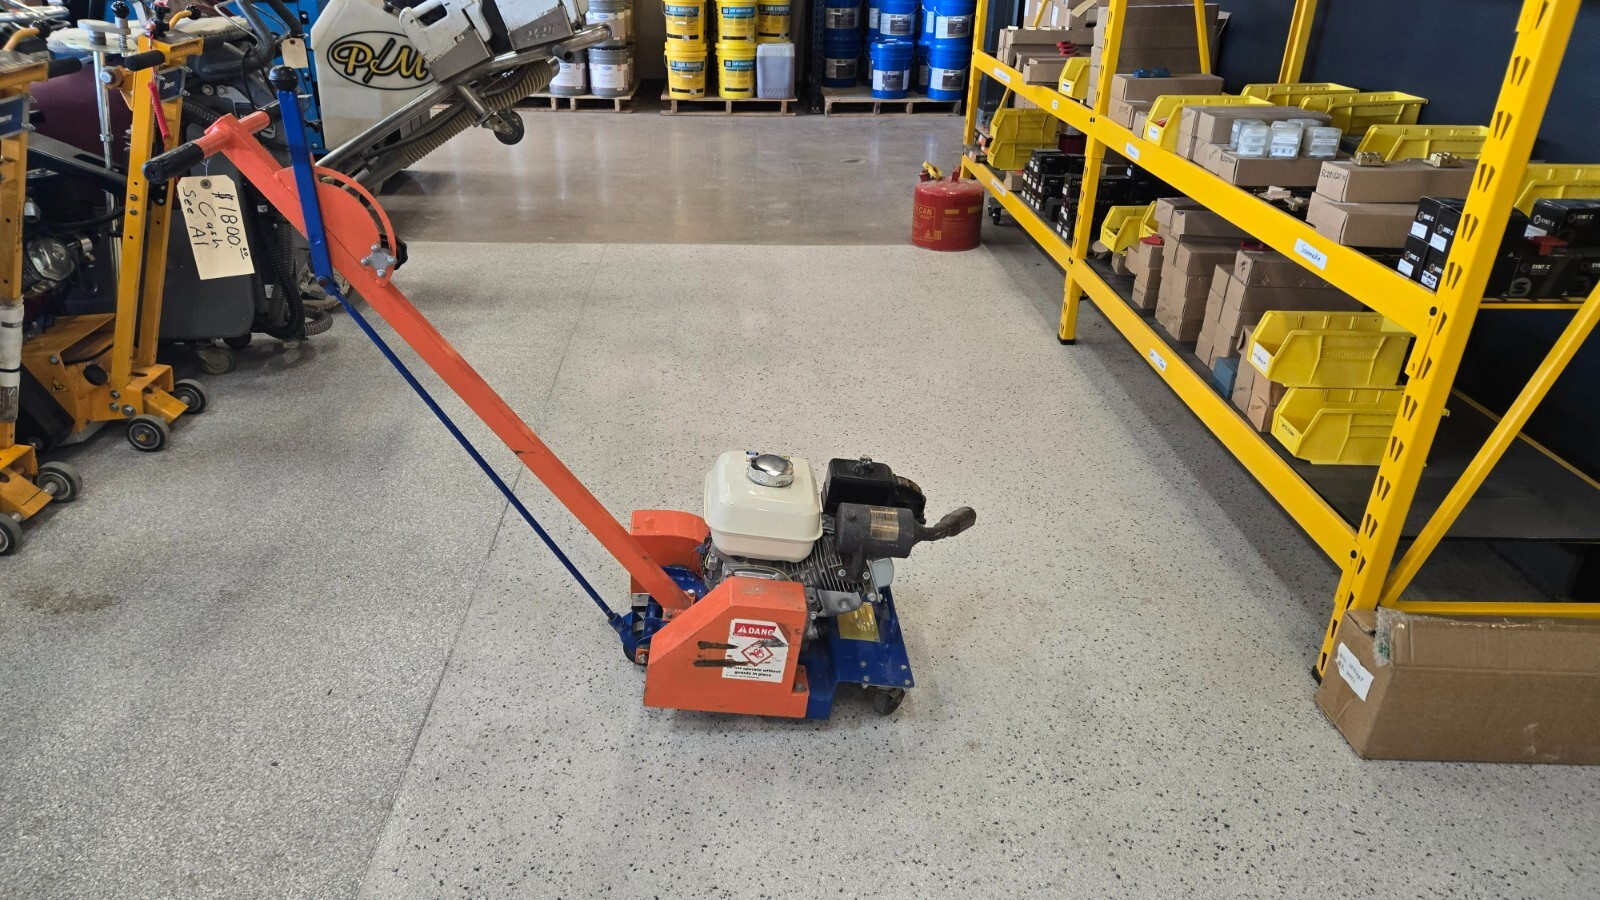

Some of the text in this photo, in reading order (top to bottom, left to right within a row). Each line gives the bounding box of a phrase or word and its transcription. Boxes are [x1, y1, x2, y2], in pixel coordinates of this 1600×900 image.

[526, 24, 555, 40] 2420
[182, 187, 198, 215] See
[918, 206, 932, 215] CAN
[198, 201, 223, 249] Cash
